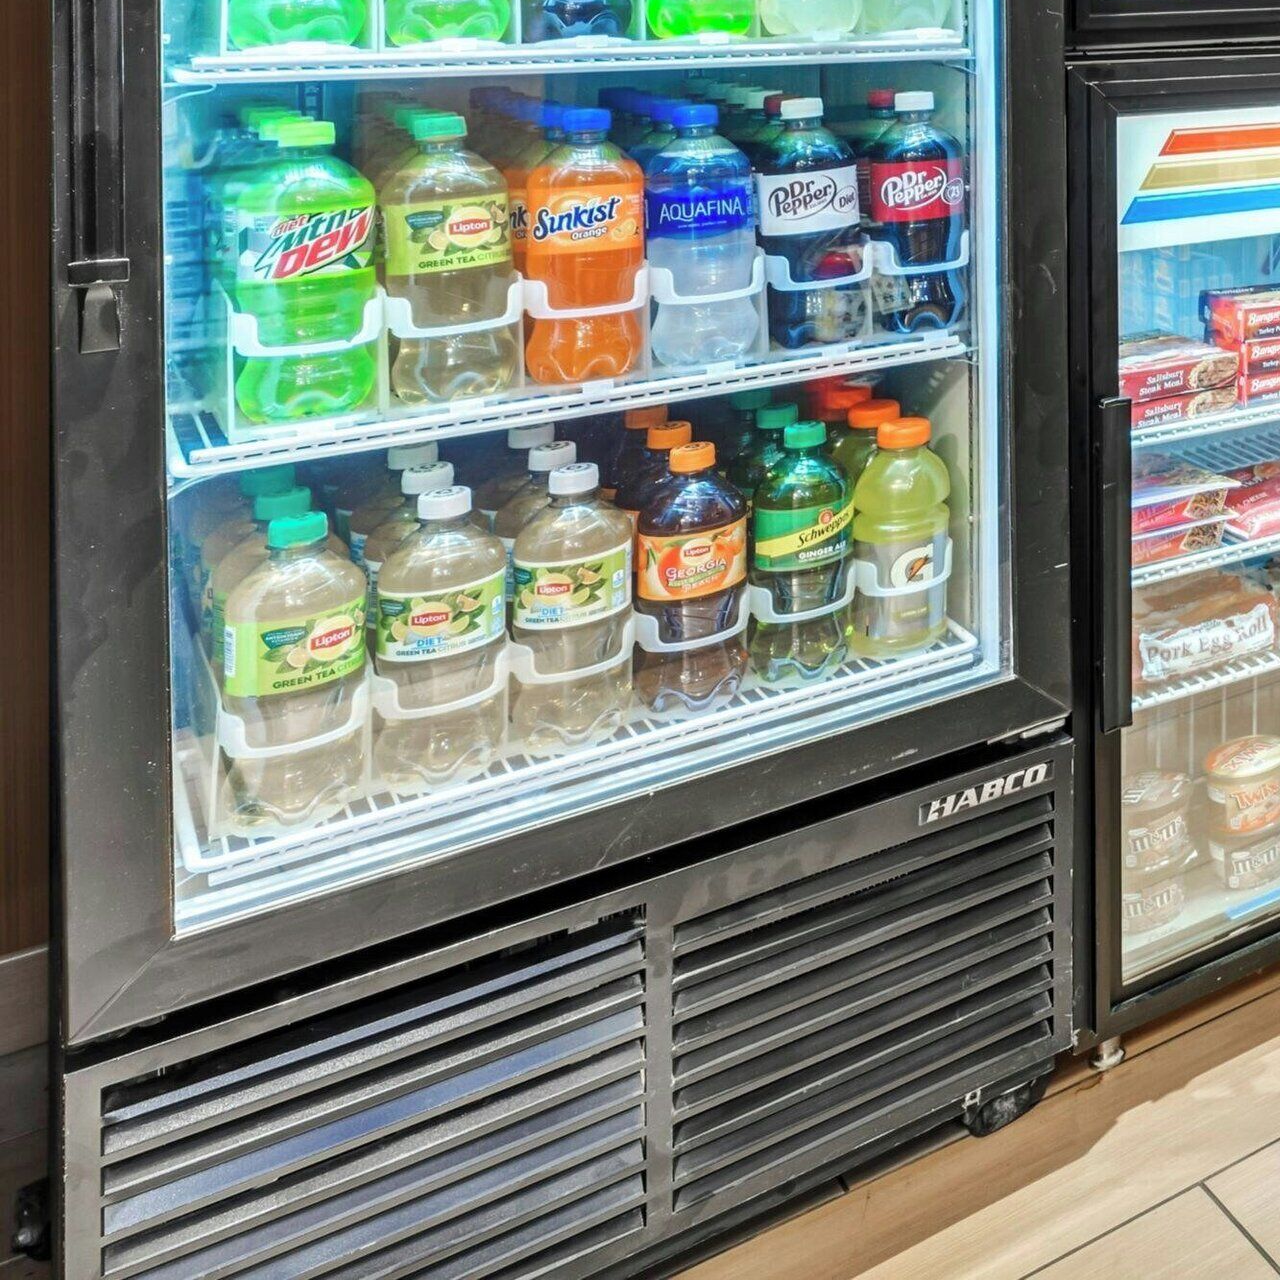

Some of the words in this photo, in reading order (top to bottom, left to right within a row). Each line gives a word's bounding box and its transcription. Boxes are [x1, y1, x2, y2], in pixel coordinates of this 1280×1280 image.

[659, 197, 746, 224] AQUAFINA
[769, 184, 833, 218] Pepper
[452, 220, 489, 235] Lipton
[533, 196, 622, 241] Sunkist
[571, 227, 609, 241] Orange
[1138, 382, 1162, 398] Steak
[1162, 376, 1184, 391] Meal
[1146, 369, 1185, 386] Salisbury
[665, 557, 727, 581] GEORGIA
[413, 613, 448, 626] Lipton
[314, 629, 352, 649] Lipton
[1145, 637, 1192, 664] Pork
[1197, 629, 1235, 655] Egg
[1236, 616, 1269, 643] Roll
[272, 676, 310, 691] GREEN
[311, 669, 338, 681] TEA
[926, 763, 1048, 823] HABCO
[1229, 783, 1280, 810] Twix
